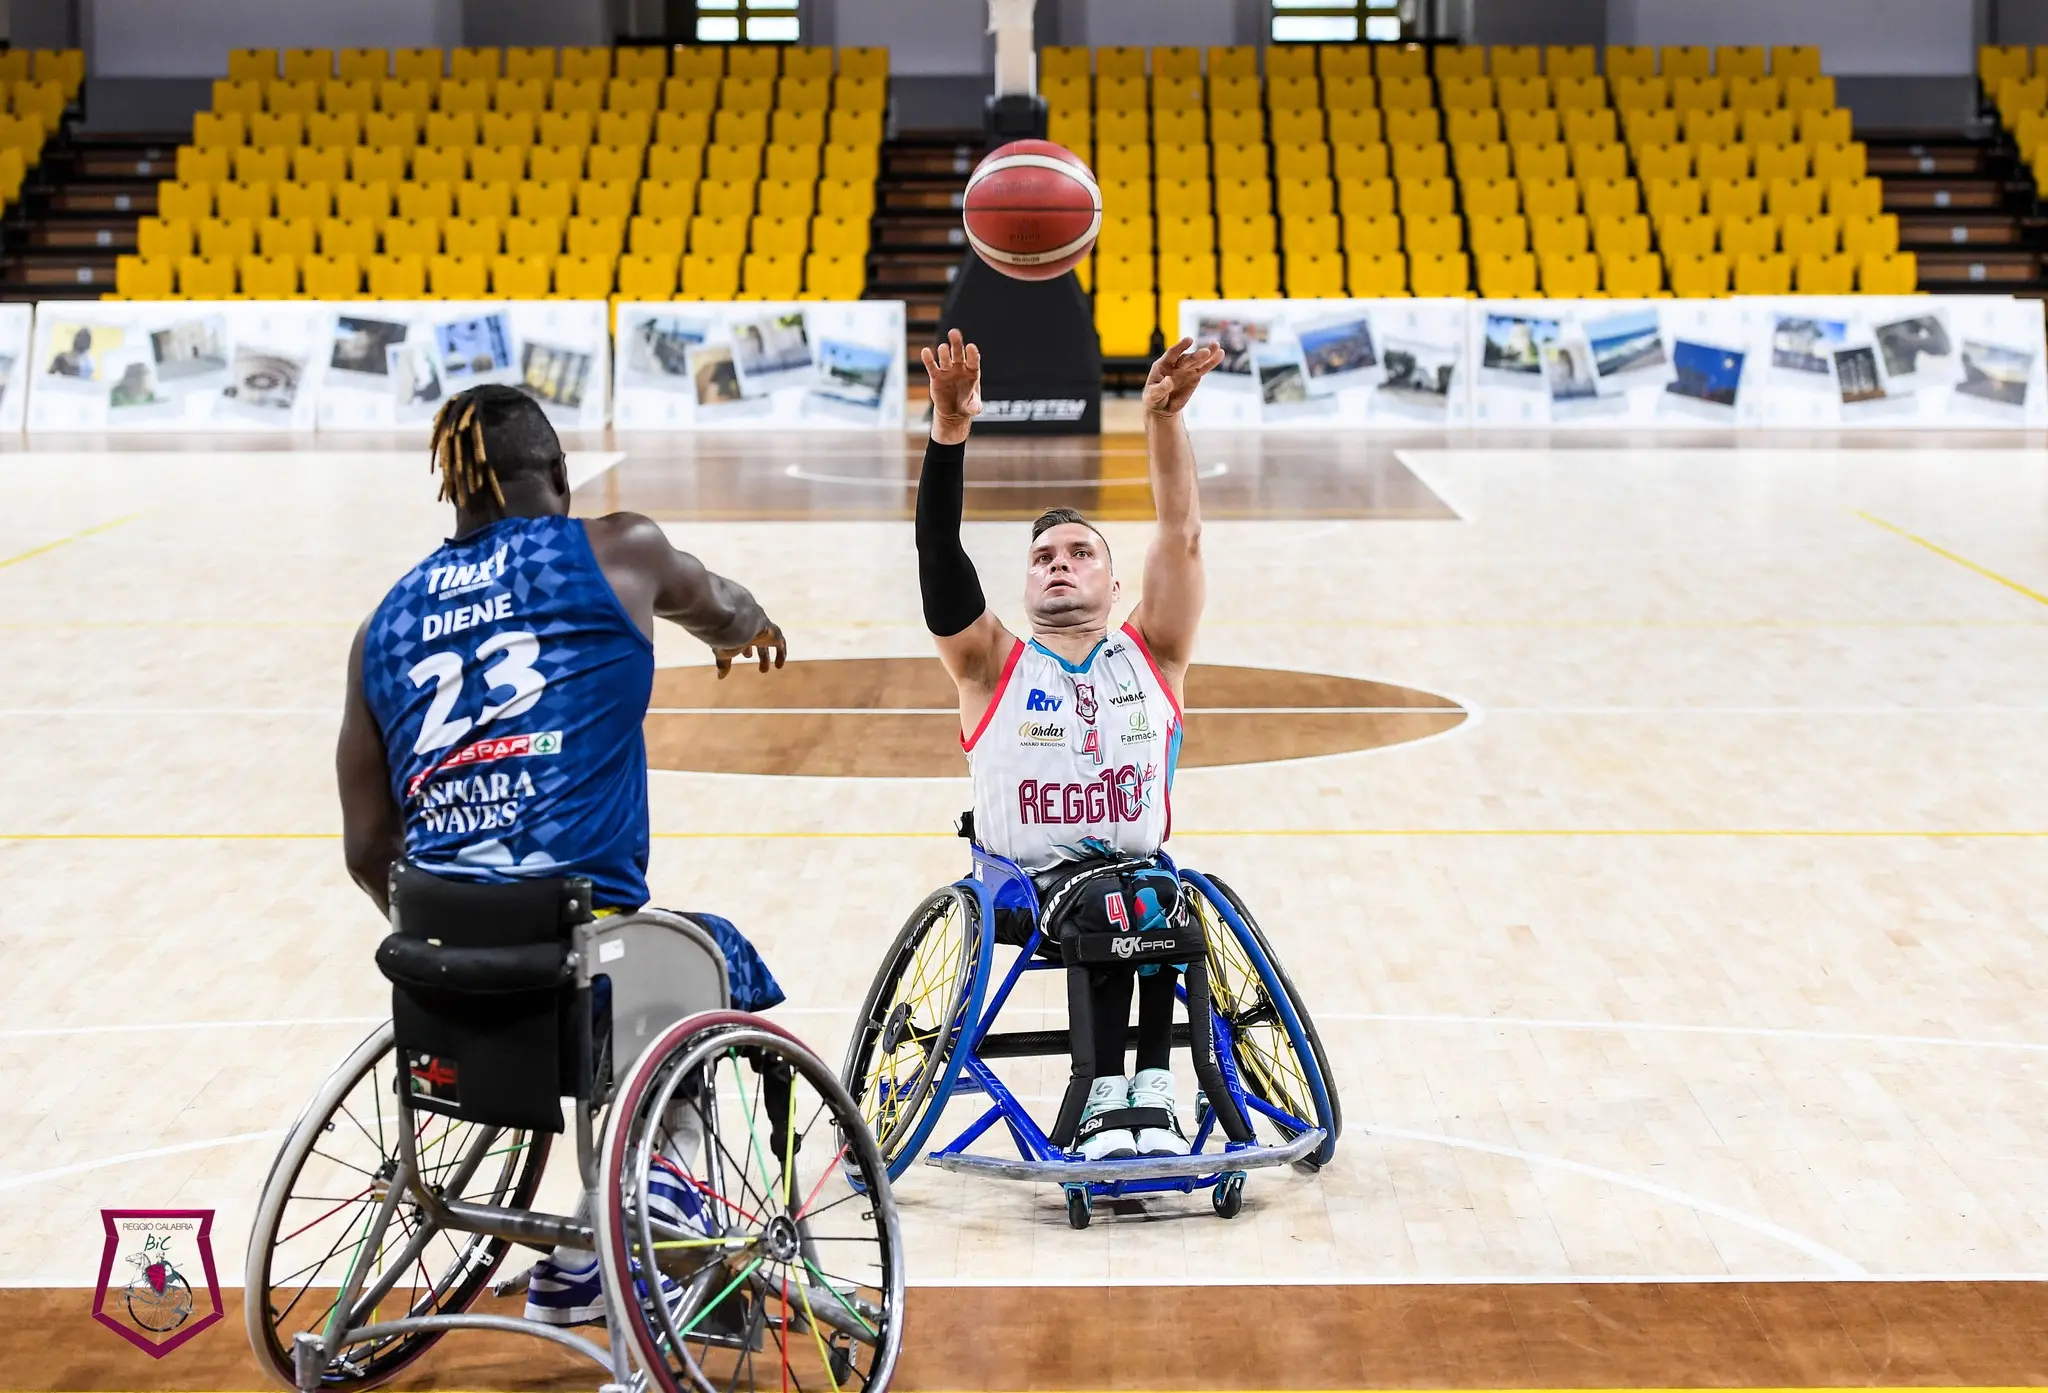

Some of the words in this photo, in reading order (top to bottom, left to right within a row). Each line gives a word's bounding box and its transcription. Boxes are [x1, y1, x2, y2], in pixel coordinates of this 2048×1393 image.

[428, 543, 508, 594] TINXY
[422, 593, 513, 642] DIENE
[407, 631, 547, 755] 23
[1018, 721, 1066, 738] Kordax
[1082, 728, 1103, 765] 4
[419, 801, 519, 833] WAVES
[1105, 892, 1130, 932] 4
[1221, 1057, 1242, 1095] ELITE
